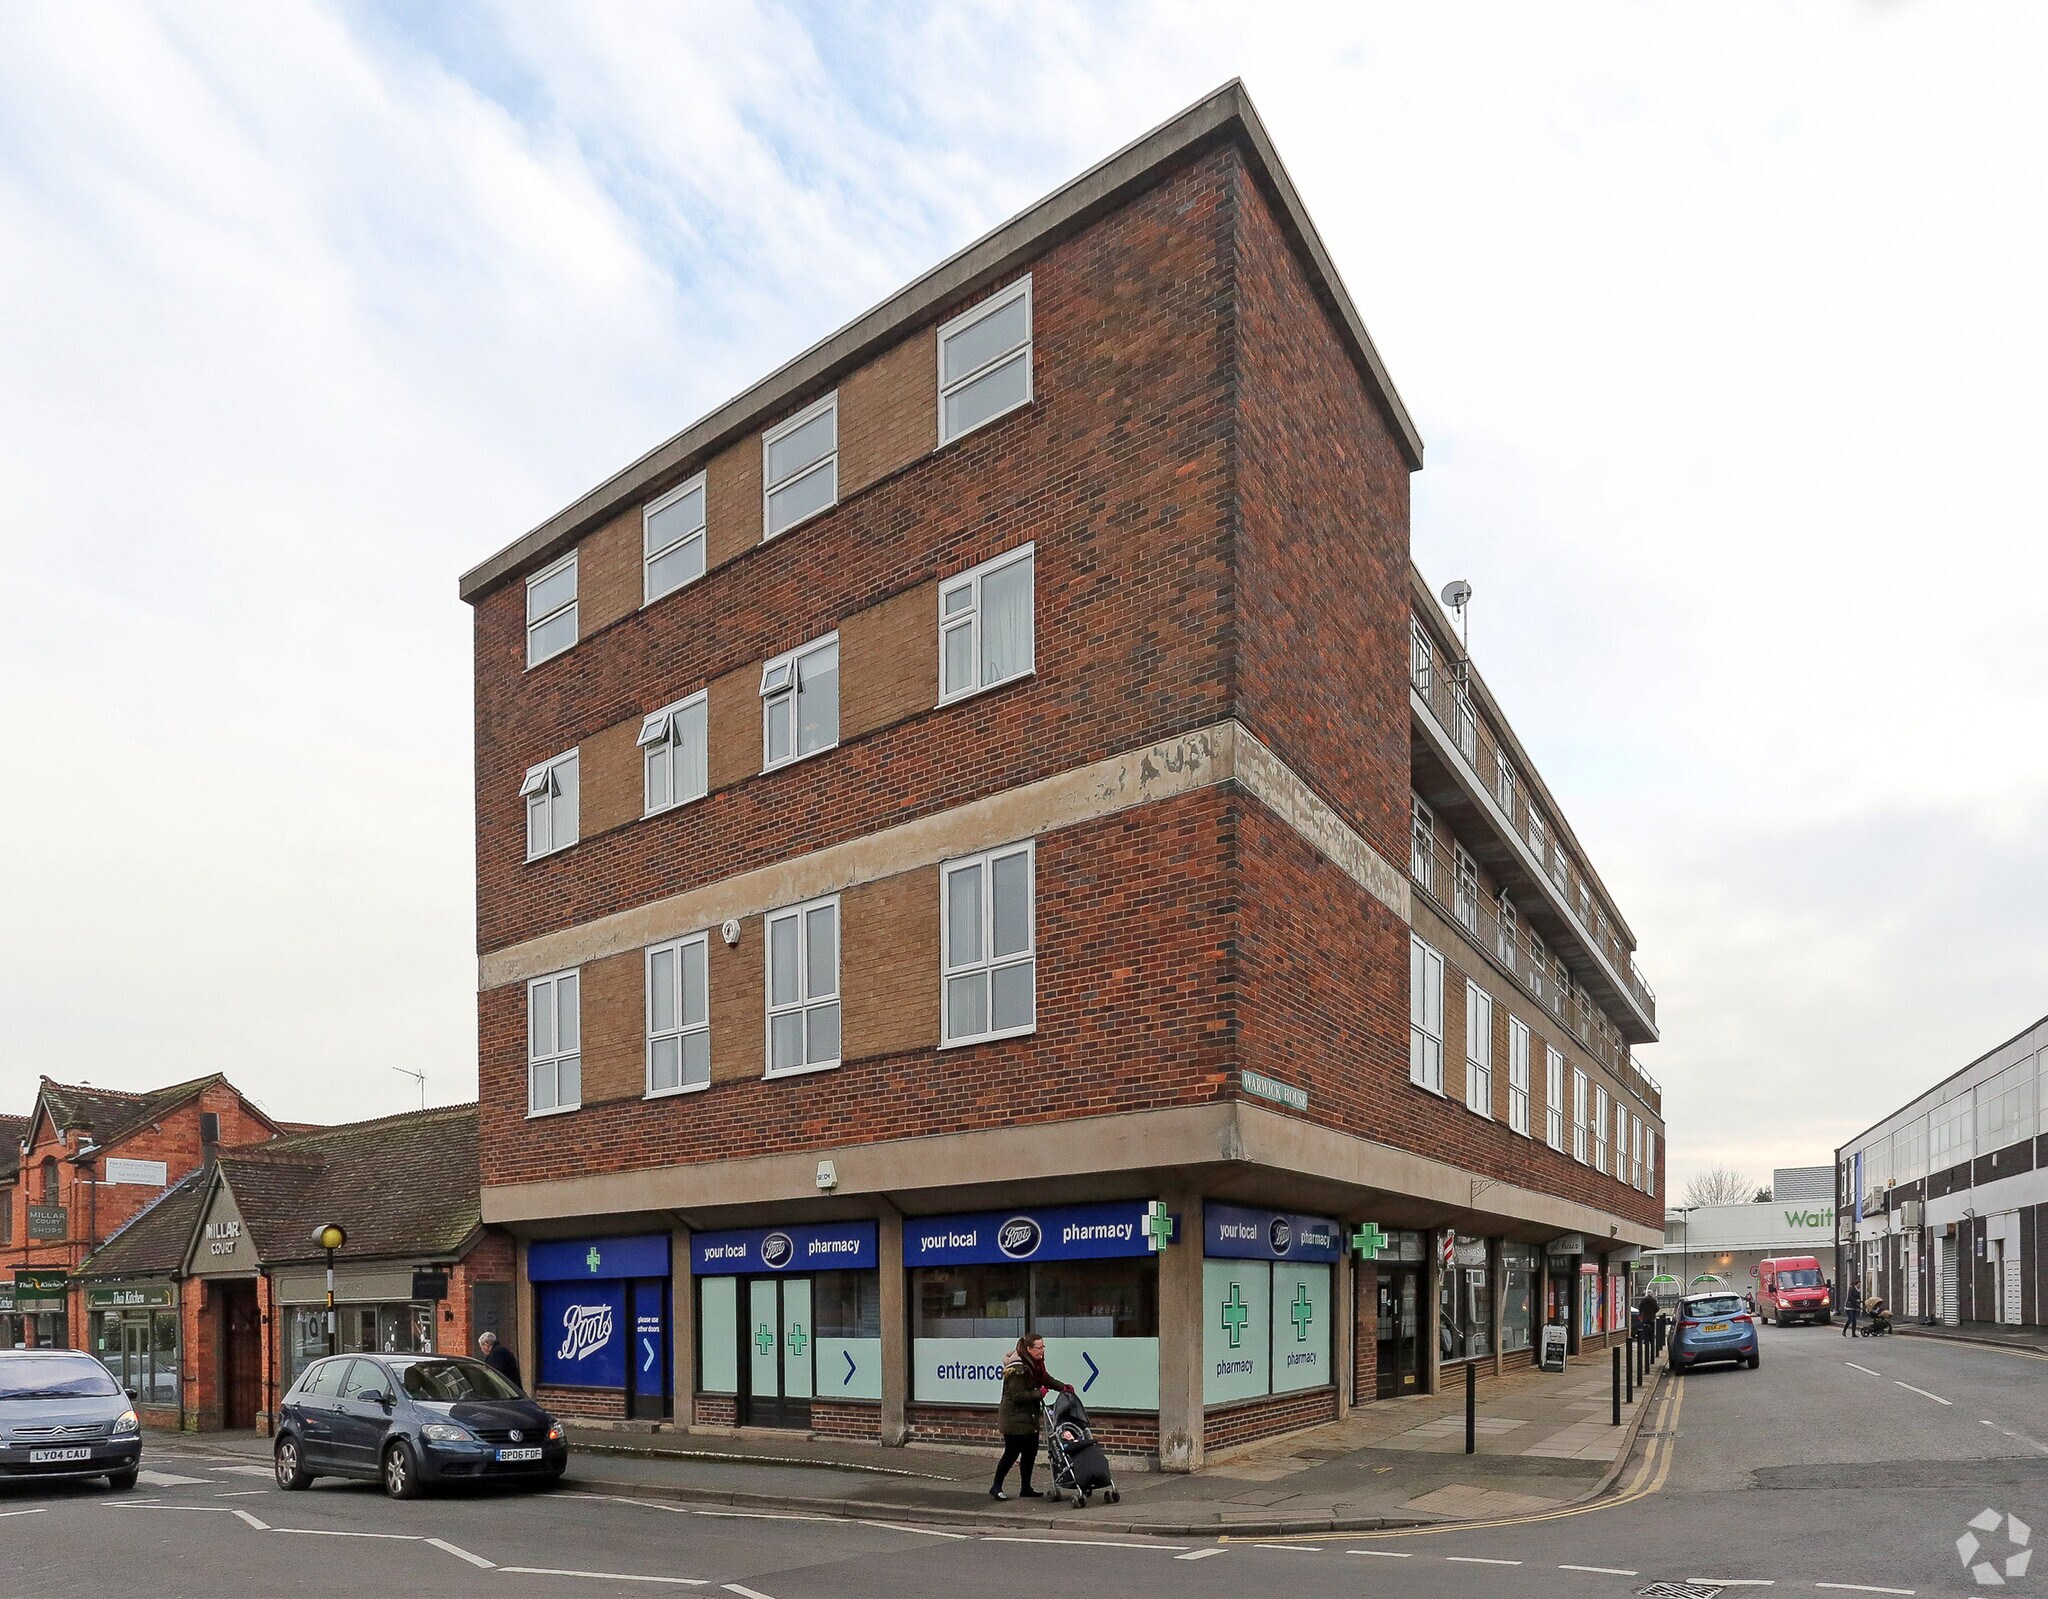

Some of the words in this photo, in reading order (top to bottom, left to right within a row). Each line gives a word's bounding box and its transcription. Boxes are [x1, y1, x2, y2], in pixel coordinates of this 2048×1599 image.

[1244, 1074, 1281, 1099] WARWICK
[1284, 1088, 1308, 1108] HOUSE
[205, 1221, 241, 1239] MILLAR
[1003, 1225, 1032, 1248] Boots
[1063, 1223, 1133, 1244] pharmacy
[1220, 1224, 1238, 1240] your
[1239, 1223, 1257, 1240] local
[211, 1241, 234, 1255] COURT
[808, 1238, 860, 1256] pharmacy
[921, 1235, 947, 1252] your
[949, 1231, 977, 1248] local
[1301, 1230, 1331, 1249] pharmacy
[1561, 1240, 1580, 1250] hair
[704, 1246, 724, 1261] your
[725, 1243, 746, 1258] local
[113, 1291, 124, 1304] Thai
[557, 1303, 613, 1361] Boots
[1216, 1359, 1254, 1378] pharmacy
[1287, 1351, 1317, 1368] pharmacy
[937, 1360, 1004, 1380] entrance
[36, 1451, 64, 1461] LY04
[66, 1449, 87, 1459] CAU
[501, 1450, 524, 1460] BP06
